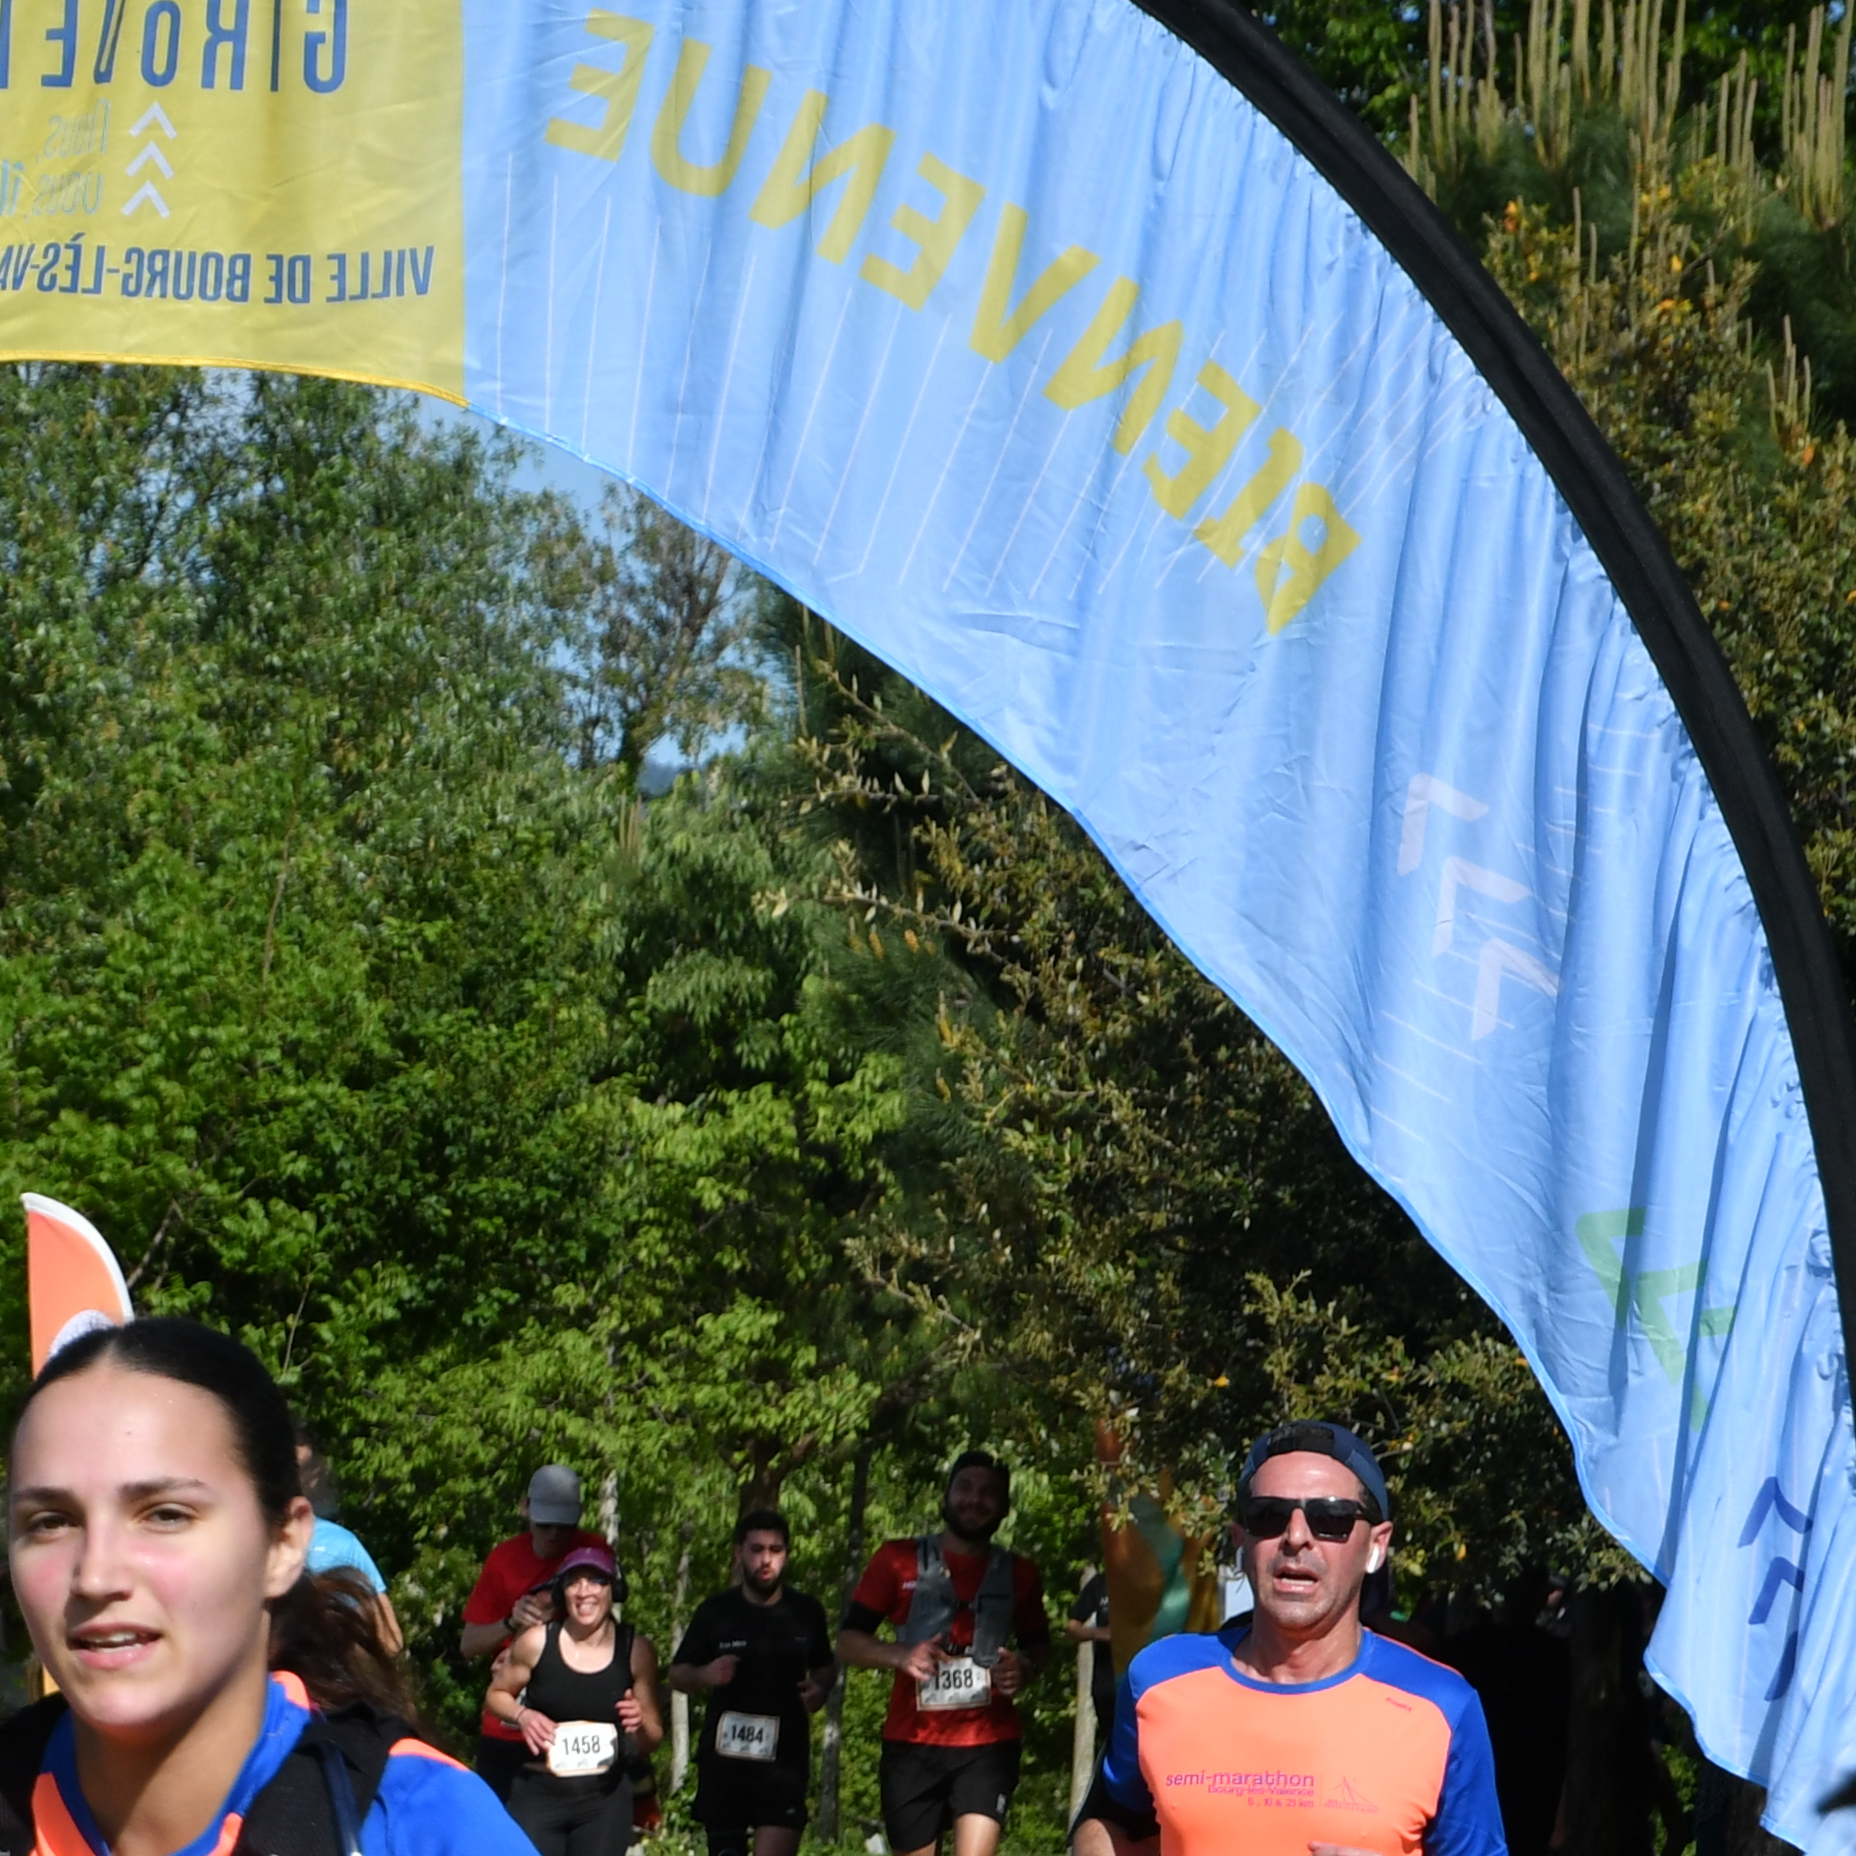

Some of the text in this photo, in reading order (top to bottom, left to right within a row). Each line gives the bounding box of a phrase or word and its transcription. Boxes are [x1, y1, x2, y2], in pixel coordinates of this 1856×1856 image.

[933, 1668, 974, 1690] 1368
[731, 1724, 764, 1744] 1484
[562, 1734, 601, 1756] 1458
[1166, 1769, 1315, 1788] semi-marathon
